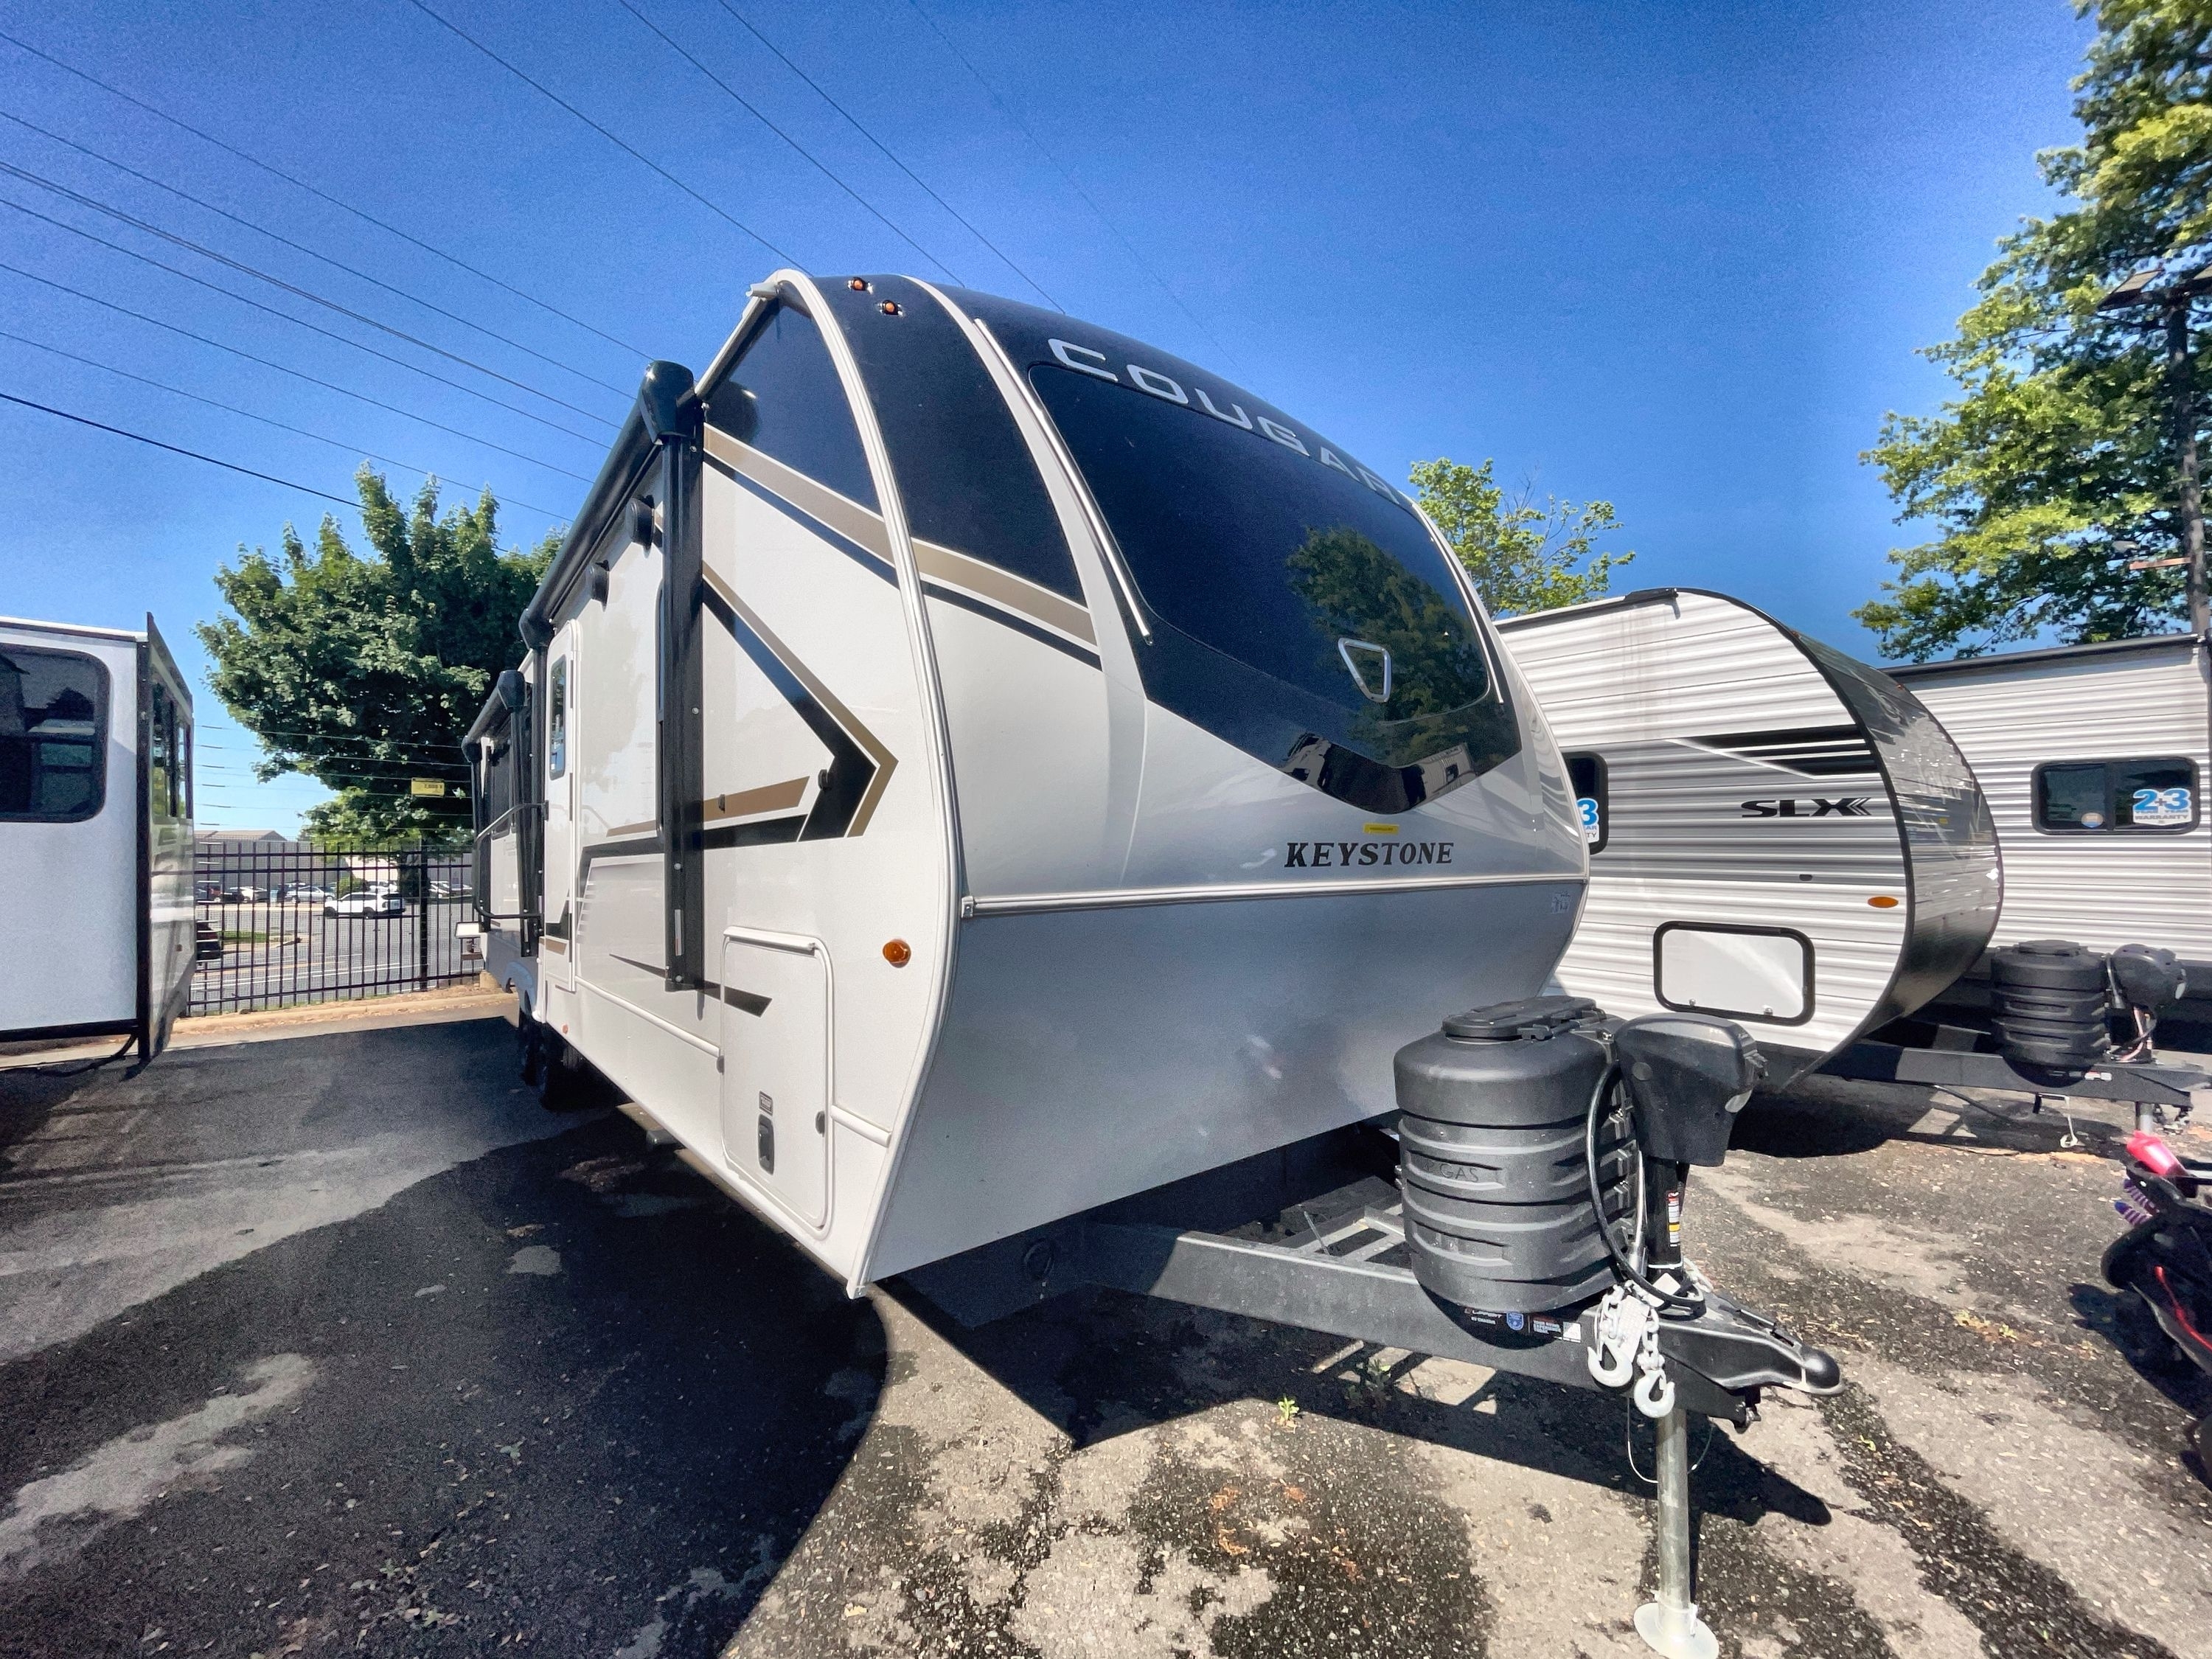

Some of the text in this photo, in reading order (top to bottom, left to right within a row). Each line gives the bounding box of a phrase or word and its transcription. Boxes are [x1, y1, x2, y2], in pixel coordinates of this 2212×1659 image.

[1048, 338, 1400, 505] COUGAR
[1741, 797, 1871, 818] SLX
[1284, 842, 1454, 868] KEYSTONE
[1439, 1163, 1479, 1183] GAS
